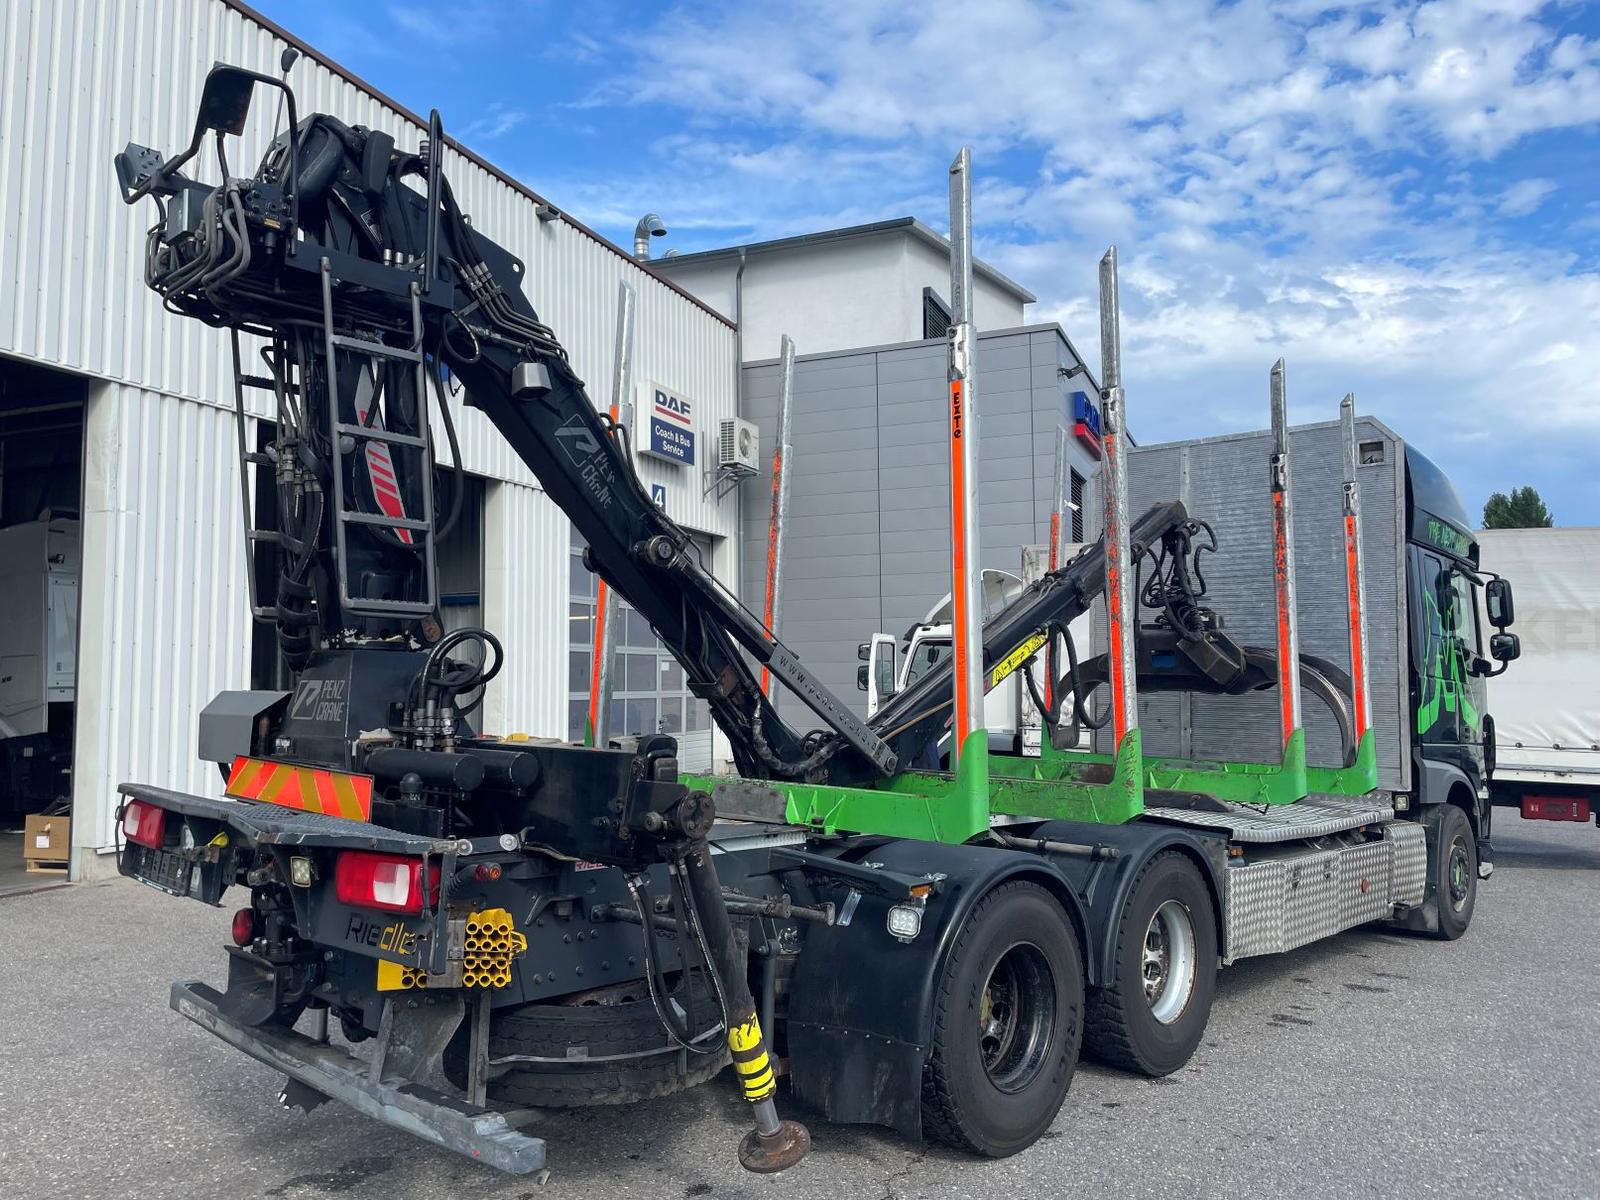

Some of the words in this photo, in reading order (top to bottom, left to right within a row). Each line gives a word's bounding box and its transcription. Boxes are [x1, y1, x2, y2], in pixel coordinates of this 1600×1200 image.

[655, 389, 691, 415] DAF
[655, 425, 675, 441] Coach
[675, 432, 679, 442] &
[680, 434, 691, 448] Bus
[662, 440, 685, 457] Service
[655, 488, 663, 508] 4
[321, 679, 346, 699] PENZ
[316, 701, 345, 721] CRANE
